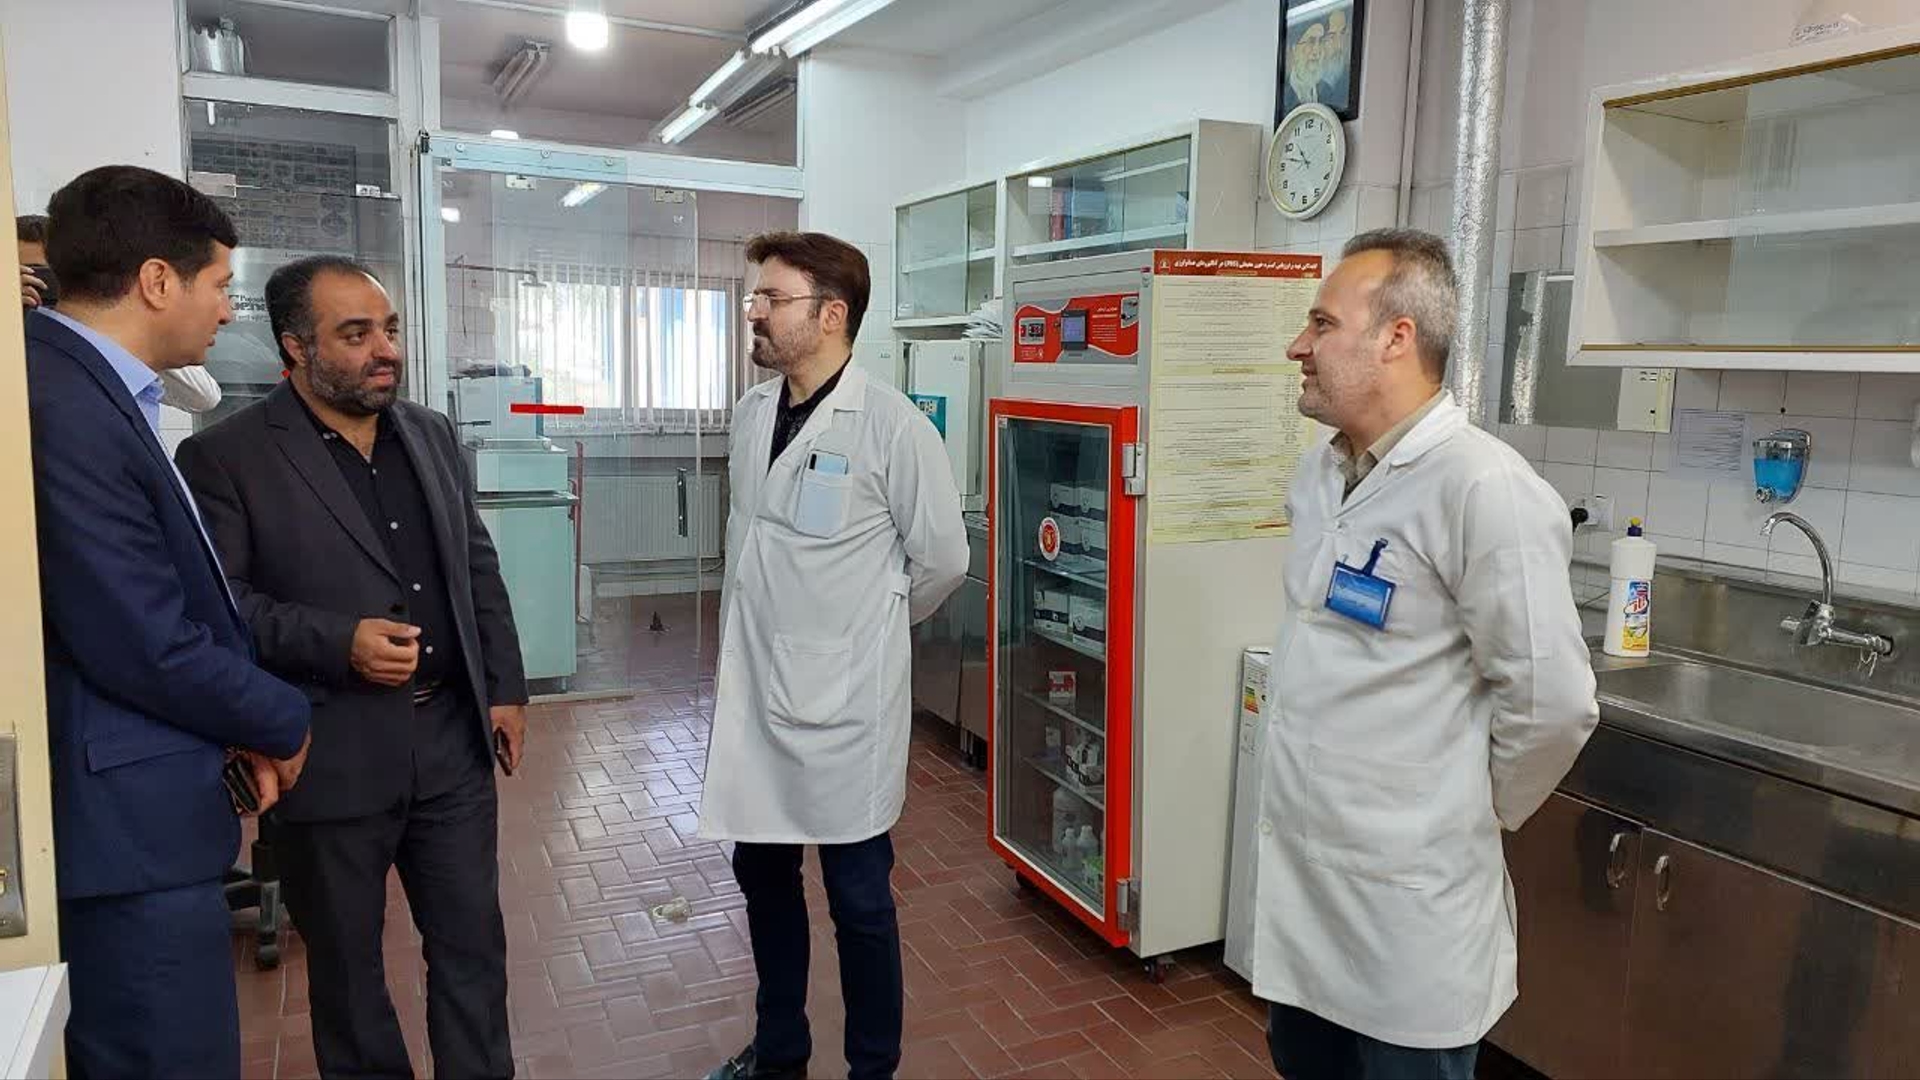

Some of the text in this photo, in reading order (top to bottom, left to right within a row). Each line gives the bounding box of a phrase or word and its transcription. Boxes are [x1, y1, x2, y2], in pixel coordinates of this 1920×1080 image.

[1305, 119, 1314, 129] 12
[1294, 127, 1300, 136] 11
[1285, 143, 1294, 153] 10
[1280, 162, 1286, 172] 9
[1290, 192, 1296, 201] 7
[1313, 188, 1320, 198] 5
[1301, 195, 1308, 204] 6
